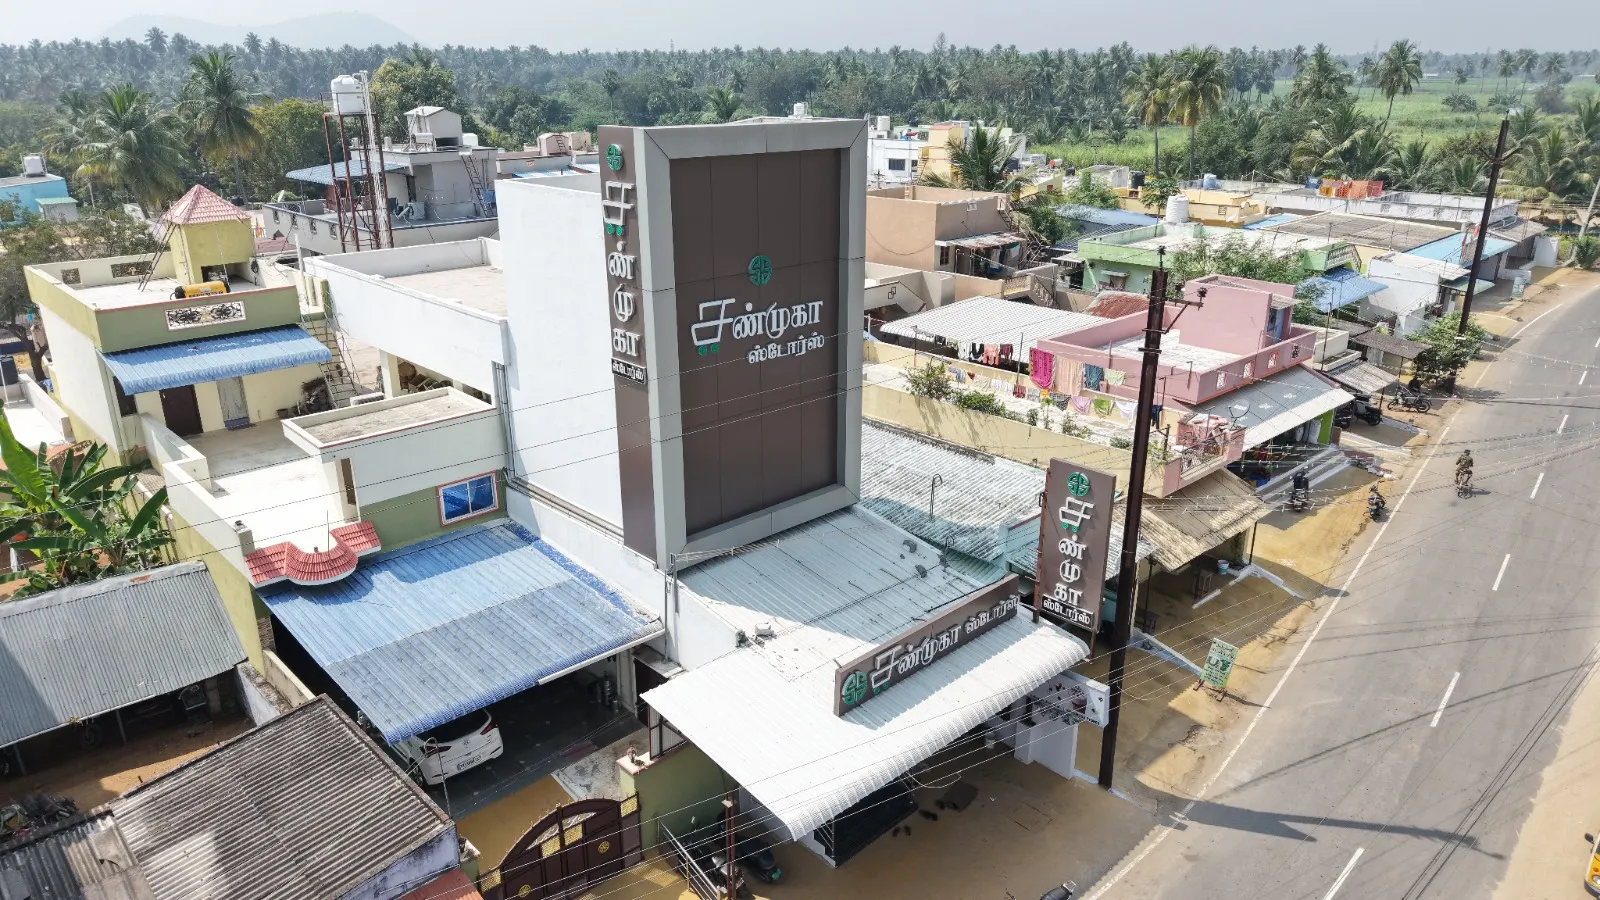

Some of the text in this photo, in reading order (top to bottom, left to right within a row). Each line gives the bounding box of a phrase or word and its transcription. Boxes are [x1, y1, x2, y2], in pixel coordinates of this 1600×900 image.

[691, 298, 823, 346] சண்முகா
[748, 331, 825, 364] ஸ்டோர்ஸ்
[1043, 599, 1091, 624] ஸ்டோர்ஸ்
[870, 626, 961, 688] சண்முகா
